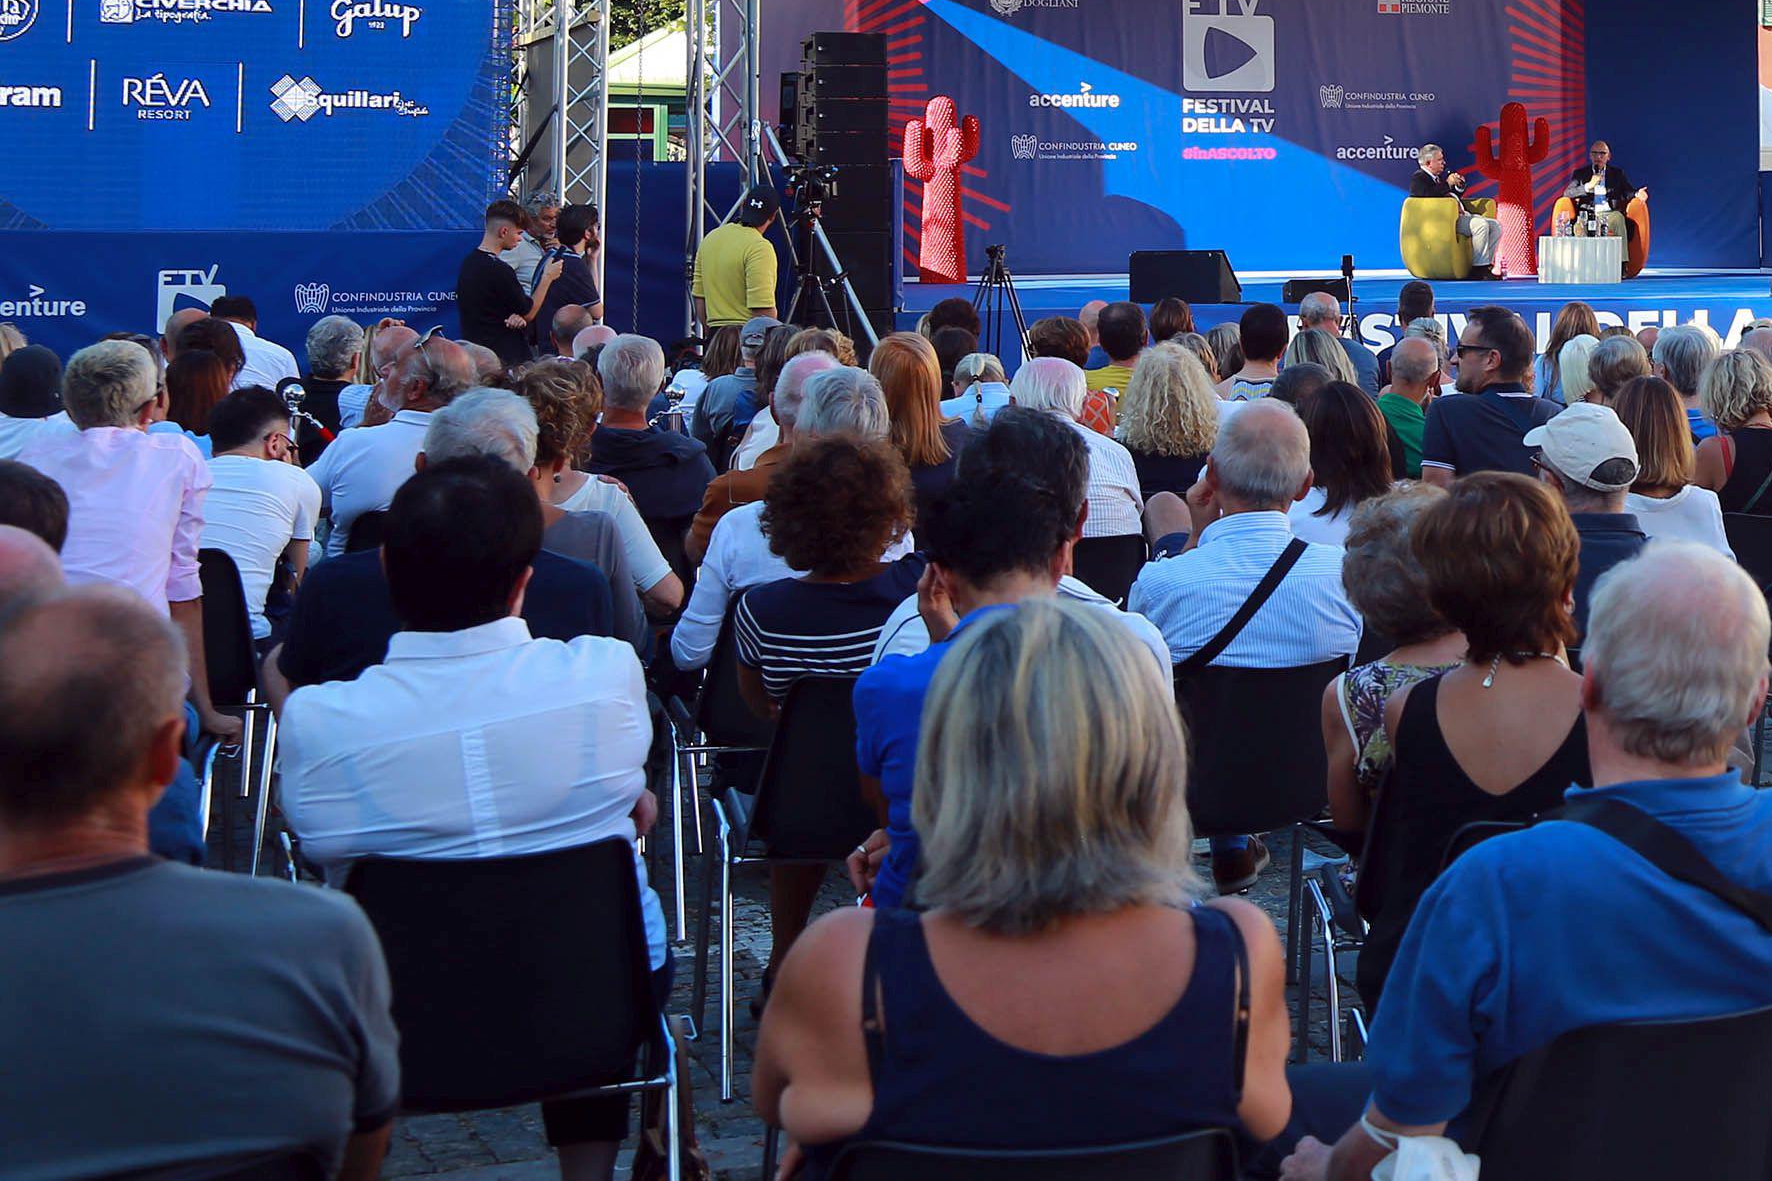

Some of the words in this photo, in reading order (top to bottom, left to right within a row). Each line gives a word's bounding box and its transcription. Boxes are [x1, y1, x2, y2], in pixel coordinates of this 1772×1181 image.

[1400, 2, 1449, 15] PIEMONTE
[122, 73, 210, 107] RÉVA
[1345, 92, 1406, 100] CONFINDUSTRIA
[1409, 93, 1435, 101] CUNEO
[1029, 91, 1120, 108] accenture
[1182, 97, 1275, 115] FESTIVAL
[138, 109, 192, 119] RESORT
[1182, 117, 1246, 133] DELLA
[1251, 117, 1275, 133] TV
[1039, 142, 1106, 151] CONFINDUSTRIA
[1108, 142, 1137, 151] CUNEO
[1337, 145, 1419, 159] accenture
[332, 291, 423, 302] CONFINDUSTRIA
[427, 291, 458, 301] CUNE
[357, 305, 390, 313] Industriale
